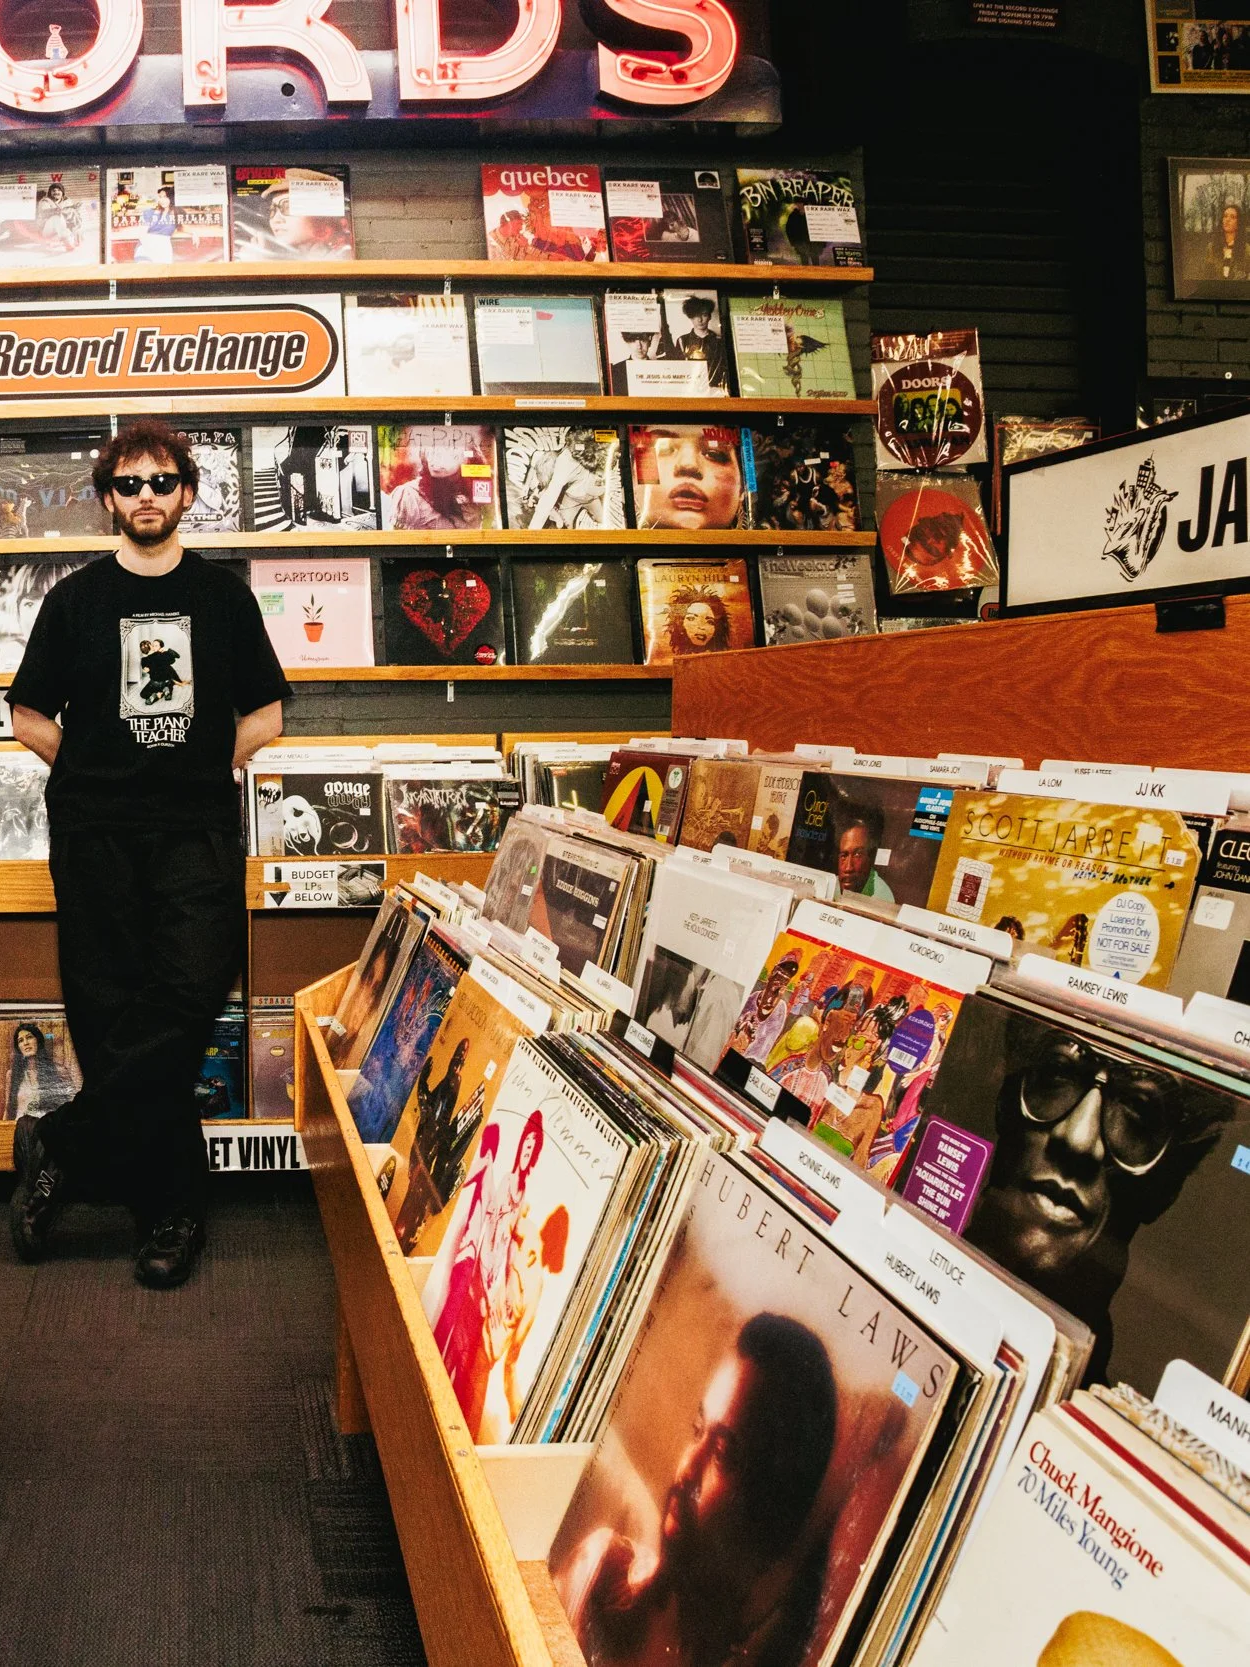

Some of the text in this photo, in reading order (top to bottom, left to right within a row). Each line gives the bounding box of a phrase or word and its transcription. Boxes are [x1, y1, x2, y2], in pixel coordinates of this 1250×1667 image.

[500, 166, 588, 190] quebec
[478, 298, 500, 306] WIRE
[129, 326, 308, 379] Exchange
[901, 374, 949, 390] DOORS
[1176, 456, 1250, 553] JA
[274, 571, 349, 583] CARRTOONS
[126, 716, 191, 731] THE PIANO
[132, 729, 187, 743] TEACHER
[323, 780, 371, 798] gouge
[1135, 782, 1167, 798] JJ KK
[962, 810, 1044, 846] SCOTT
[999, 848, 1109, 875] WITHOUT RHYME OR REASON
[291, 869, 335, 881] BUDGET
[305, 881, 322, 892] LPs
[294, 892, 334, 903] BELOW
[1116, 897, 1147, 913] DJ Copy
[1109, 913, 1146, 927] Loaned for
[936, 922, 977, 942] DIANA KRALL
[1101, 923, 1152, 940] Promotion Only
[908, 941, 945, 964] KOKOROKO
[1096, 938, 1151, 955] NOT FOR SALE
[1067, 975, 1129, 1005] RAMSEY LEWIS
[518, 1039, 621, 1151] JOHN KLEMMER BAREFOOT BALLET
[205, 1135, 302, 1171] ET VINYL
[937, 1141, 968, 1163] RAMSEY
[798, 1150, 841, 1190] RONNIE LAWS
[936, 1153, 960, 1173] LEWIS
[916, 1195, 938, 1215] SHINE
[921, 1183, 952, 1209] THE SUN
[928, 1248, 967, 1287] LETTUCE
[699, 1159, 945, 1399] HUBERT LAWS
[883, 1251, 942, 1307] HUBERT LAWS
[1029, 1439, 1165, 1579] Chuck Mangione
[1017, 1465, 1131, 1592] 70 Miles Young
